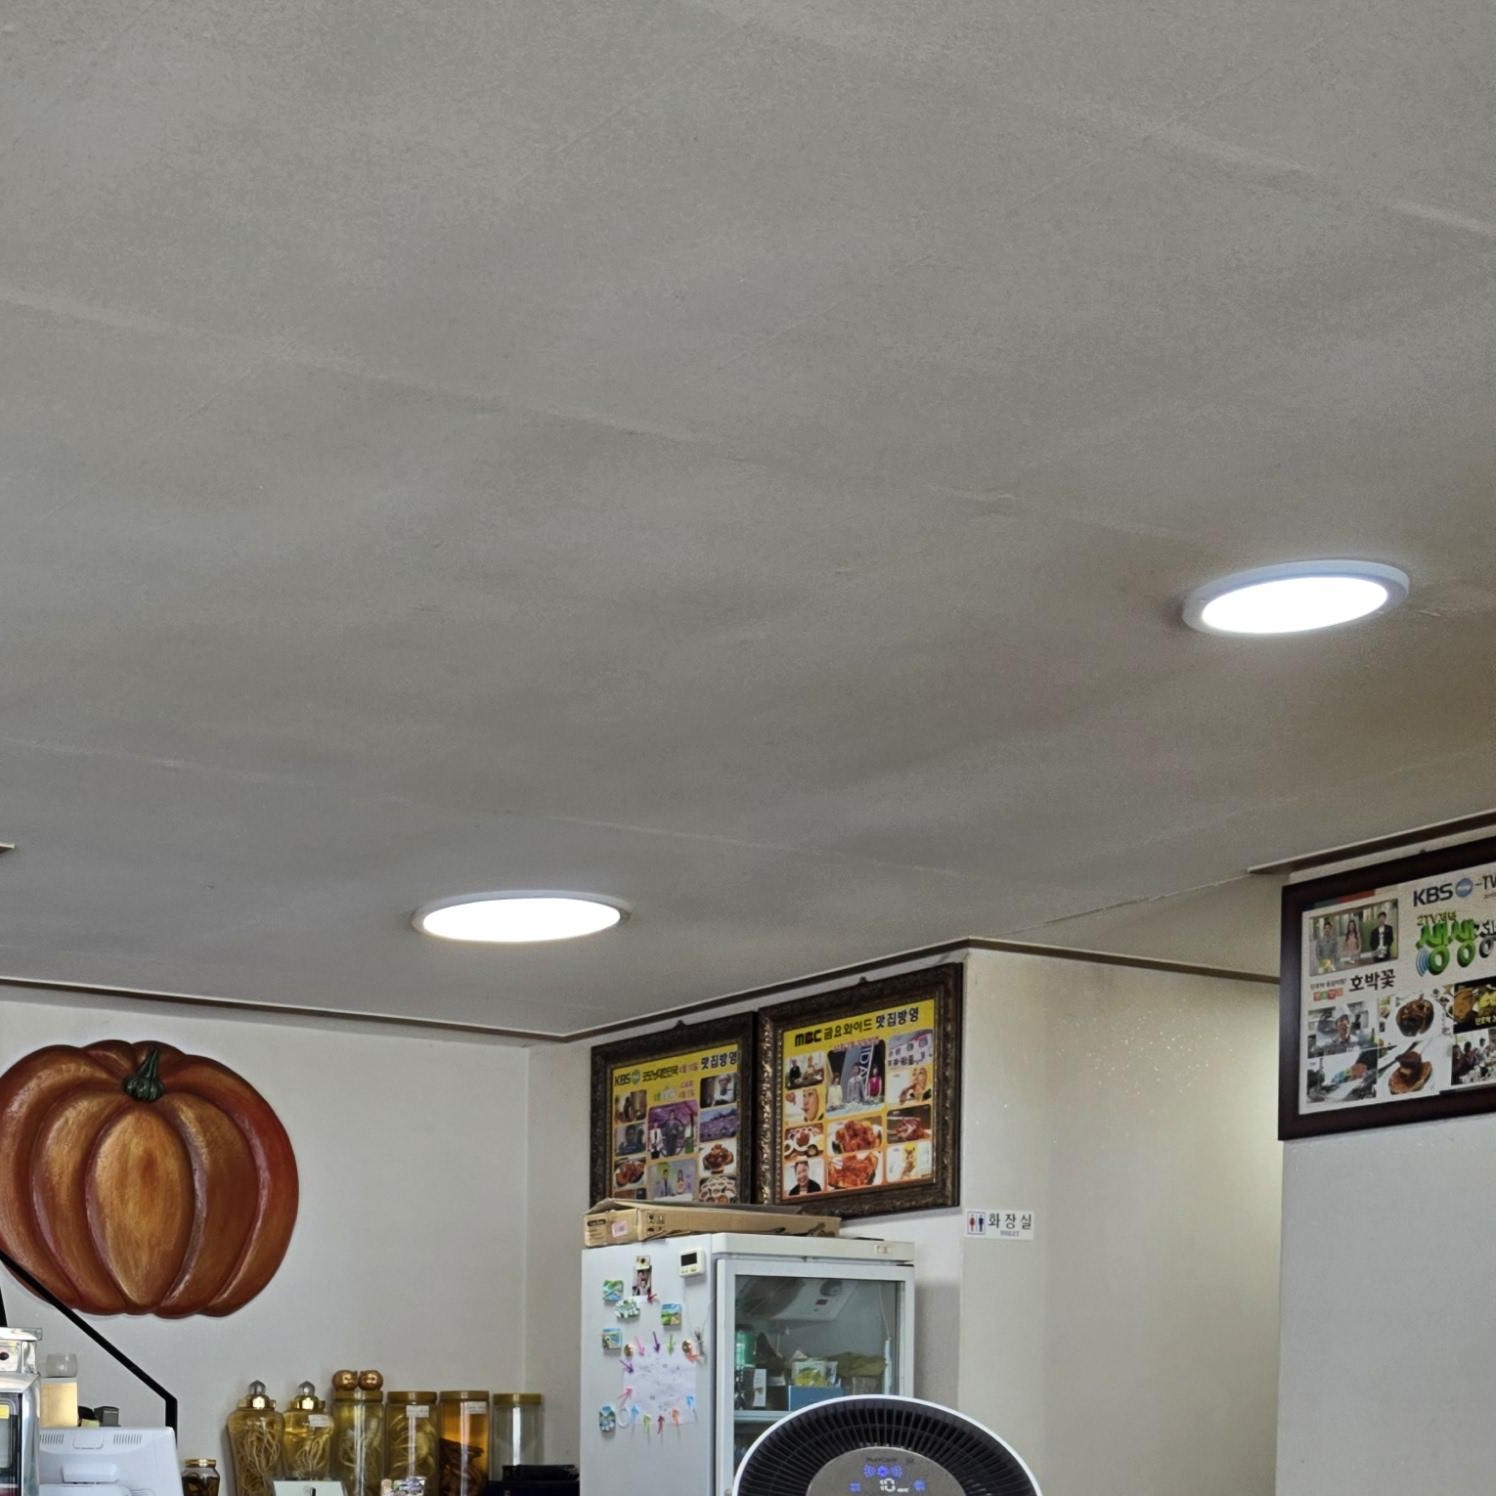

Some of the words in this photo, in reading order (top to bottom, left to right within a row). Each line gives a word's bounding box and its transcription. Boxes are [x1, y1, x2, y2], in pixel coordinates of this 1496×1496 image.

[1413, 883, 1453, 907] KBS
[1349, 969, 1395, 992] 호박꽃
[794, 1029, 822, 1047] MBC
[823, 1018, 873, 1041] 금요와이드
[875, 1007, 919, 1029] 맛집방영
[614, 1073, 631, 1086] KBS
[701, 1051, 737, 1070] 맛집방영
[988, 1213, 1032, 1230] 화장실
[880, 1477, 896, 1493] 10
